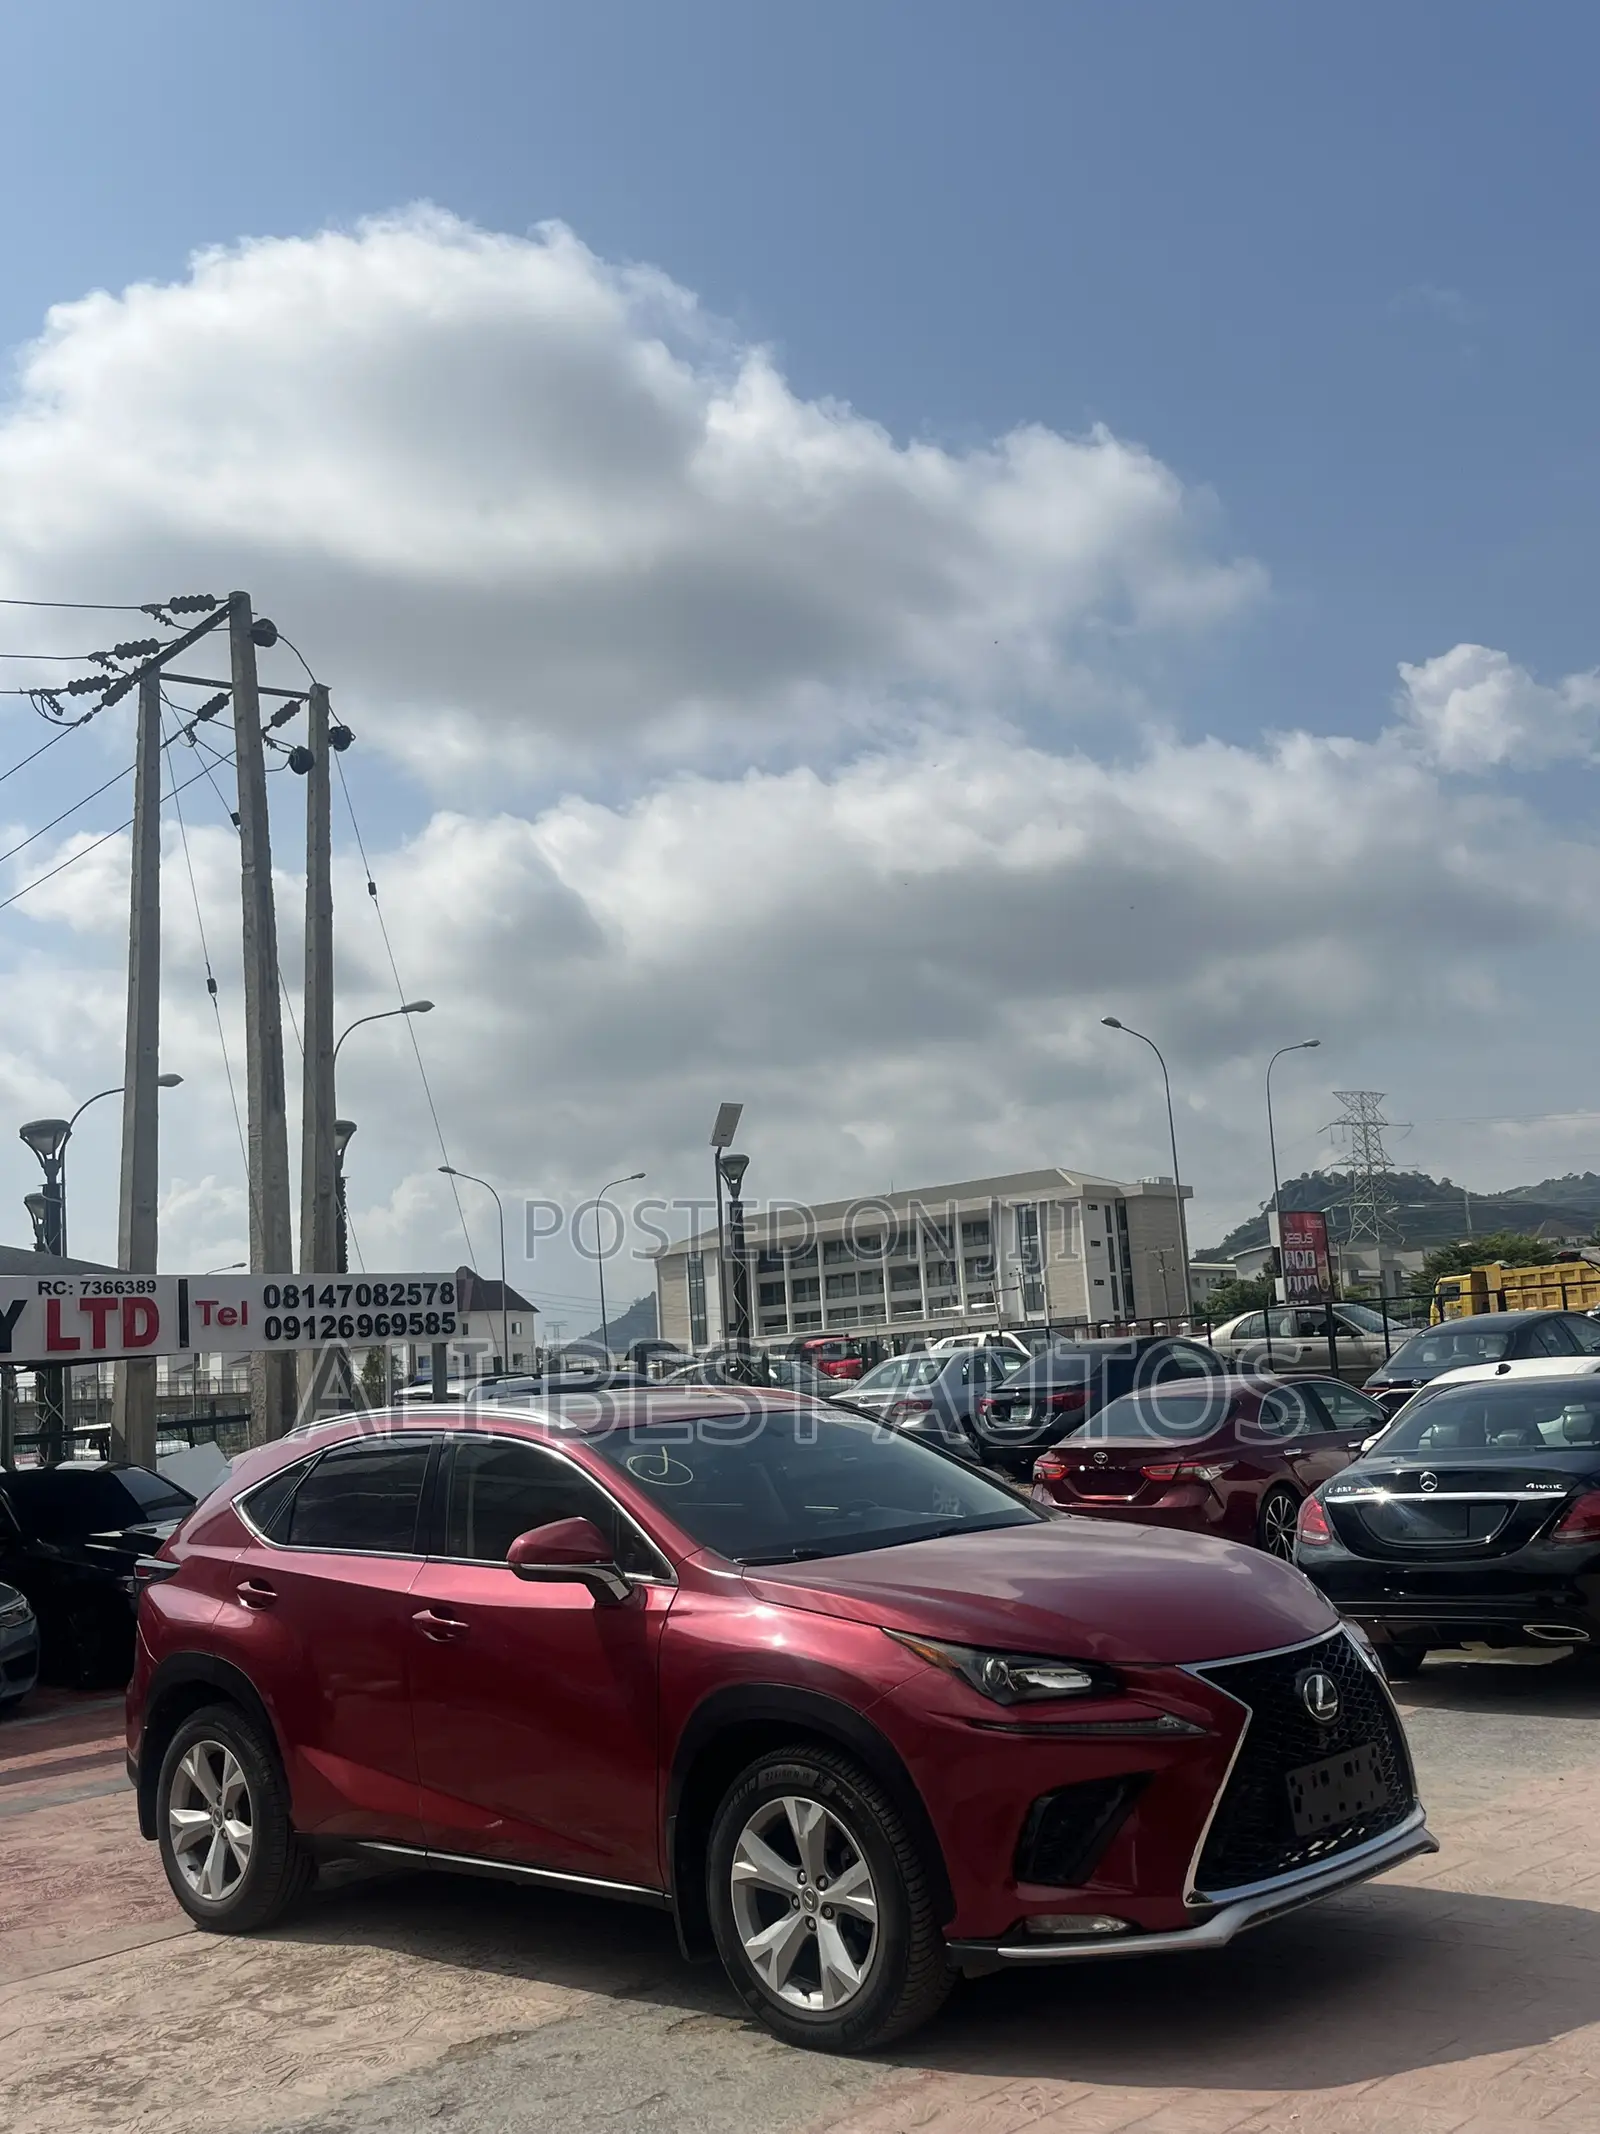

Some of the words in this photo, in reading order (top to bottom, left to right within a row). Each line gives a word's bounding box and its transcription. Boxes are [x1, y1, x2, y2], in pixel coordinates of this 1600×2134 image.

[38, 1281, 74, 1296] RC:
[80, 1279, 157, 1295] 7366389
[263, 1282, 455, 1309] 08147082578
[46, 1296, 160, 1351] LTD
[195, 1300, 249, 1326] Tel
[264, 1311, 457, 1341] 09126969585
